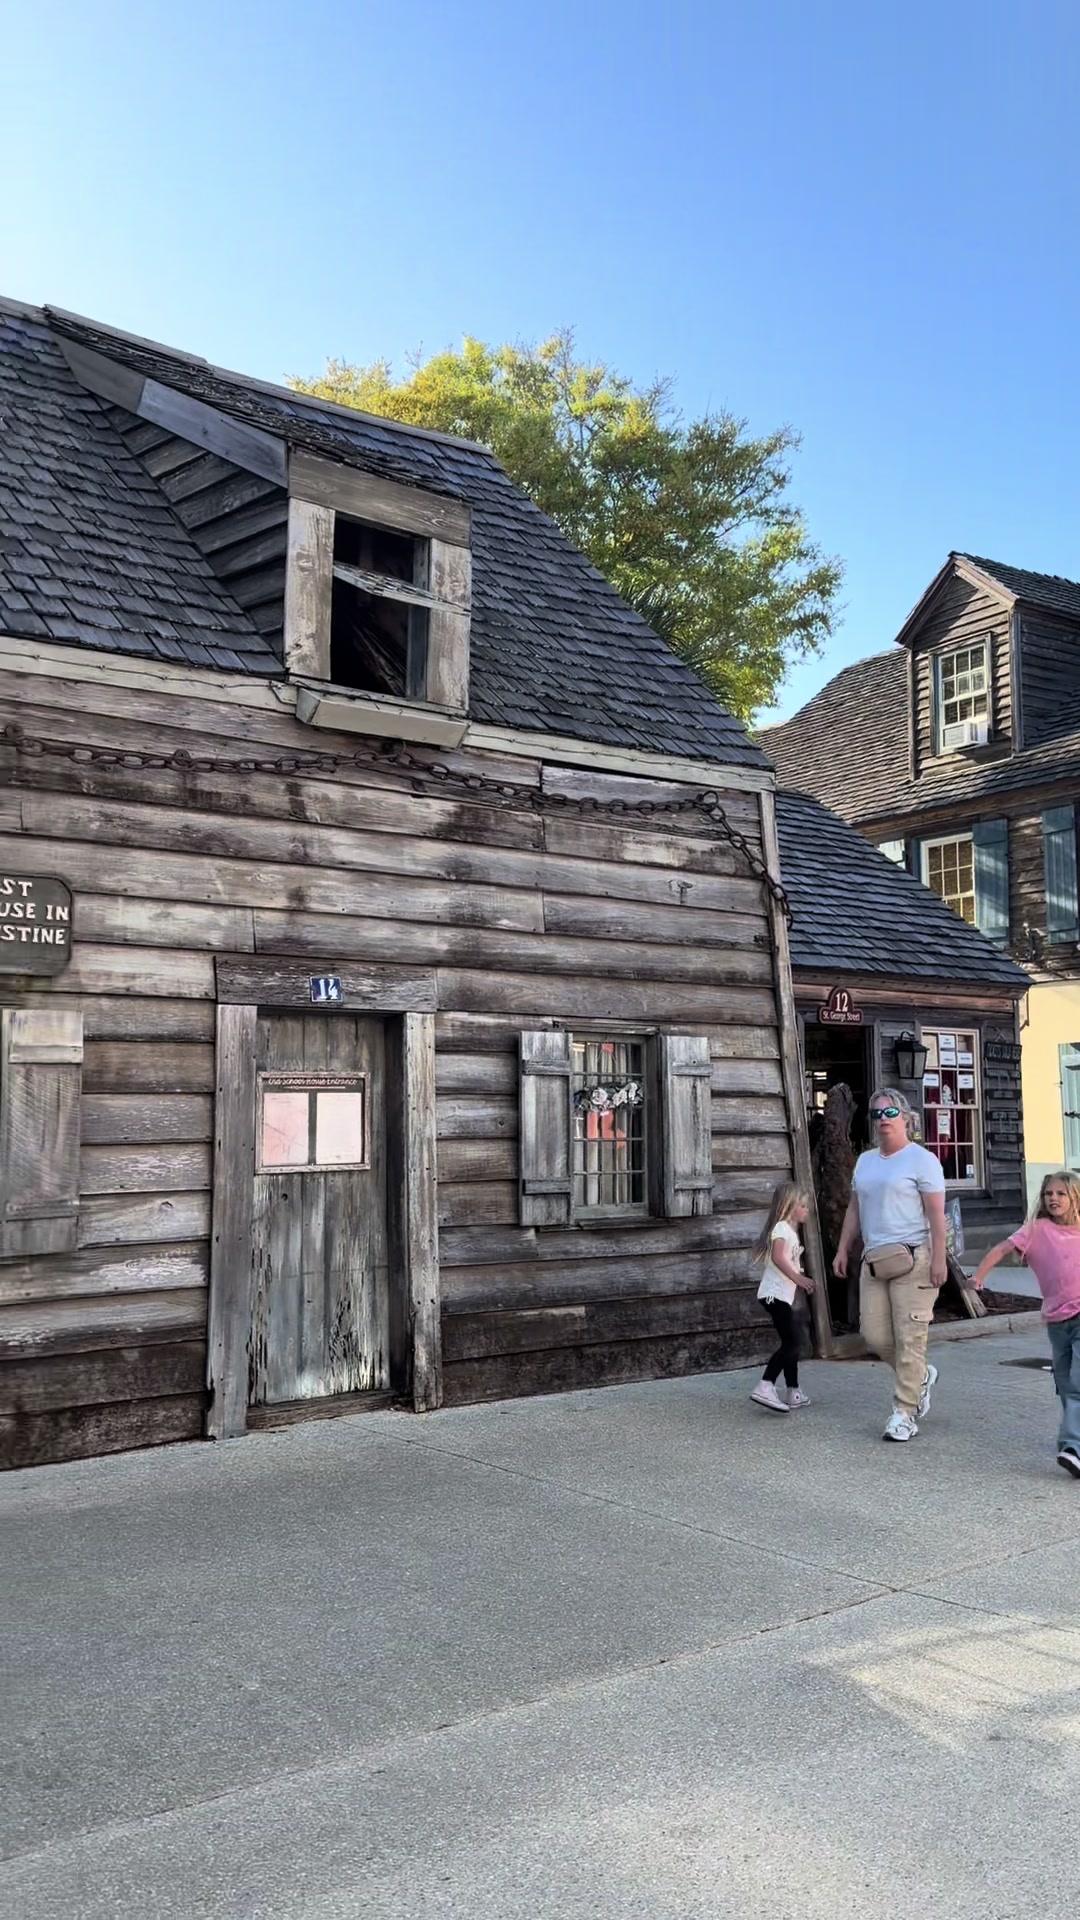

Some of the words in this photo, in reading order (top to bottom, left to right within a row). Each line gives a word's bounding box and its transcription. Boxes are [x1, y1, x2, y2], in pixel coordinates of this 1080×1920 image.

[46, 905, 69, 920] IN
[0, 925, 65, 944] STINE
[316, 978, 339, 1000] 14
[835, 992, 848, 1012] 12
